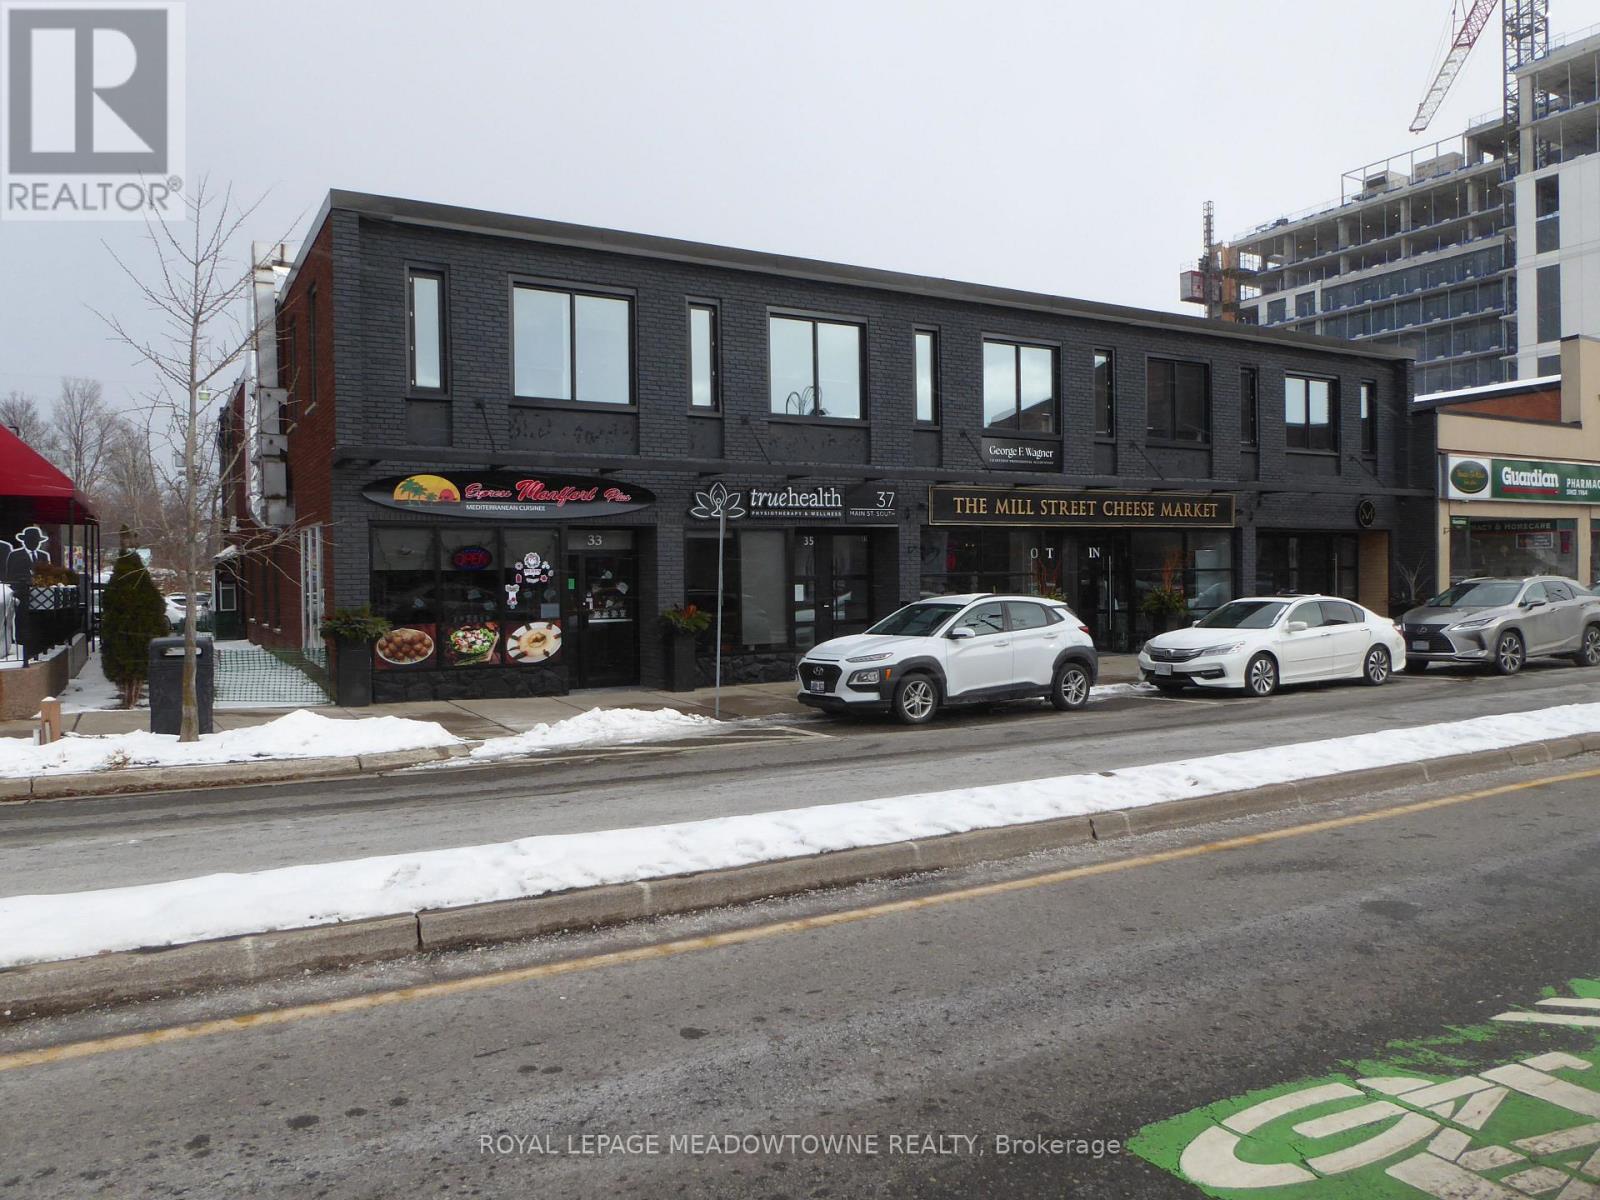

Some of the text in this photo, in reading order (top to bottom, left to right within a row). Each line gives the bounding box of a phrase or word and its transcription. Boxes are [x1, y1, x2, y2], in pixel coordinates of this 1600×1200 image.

[989, 445, 1017, 458] George
[1025, 447, 1054, 460] Wagner
[1502, 466, 1559, 488] Guardian
[750, 486, 842, 507] truehealth
[876, 491, 895, 508] 37
[953, 497, 1218, 518] THE MILL STREET CHEESE MARKET
[587, 534, 602, 546] 33
[803, 536, 814, 546] 35
